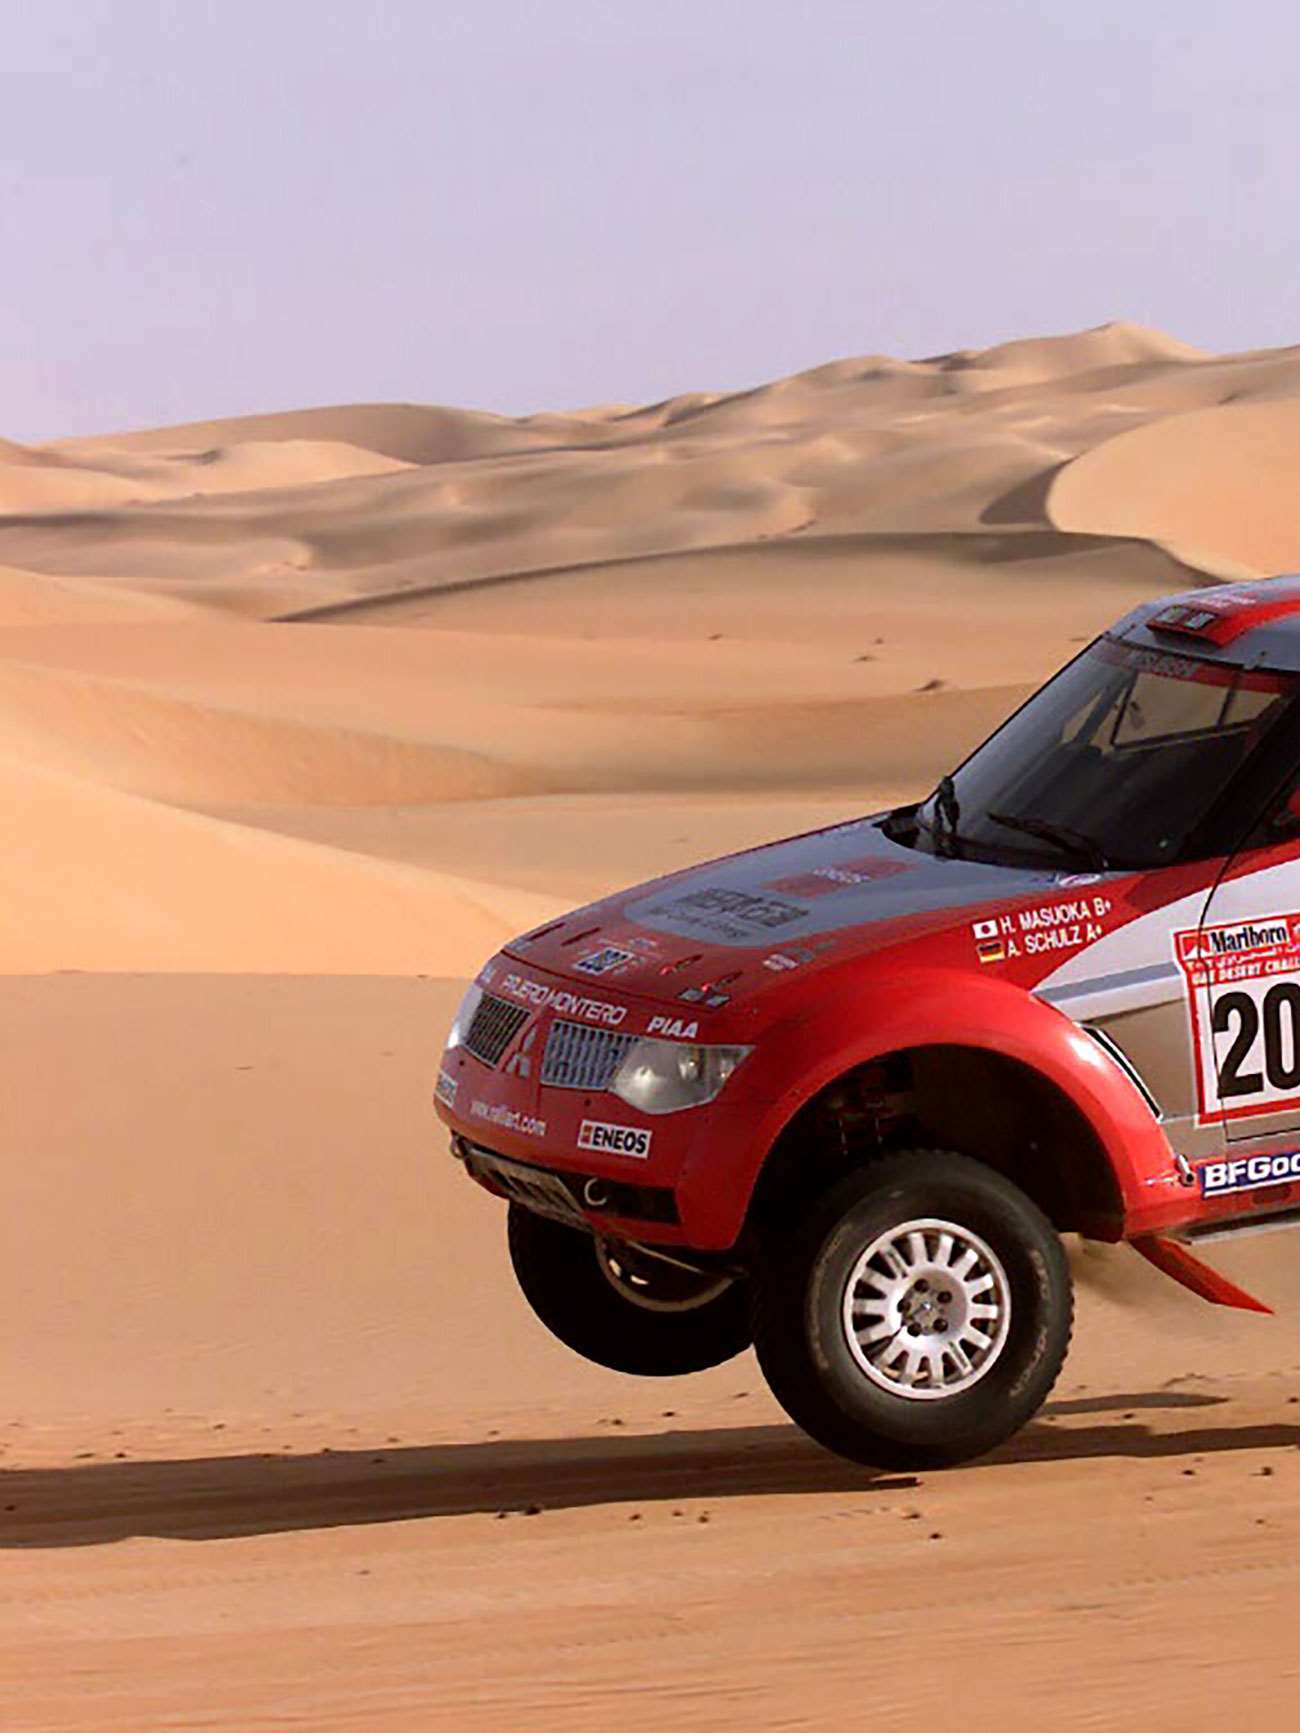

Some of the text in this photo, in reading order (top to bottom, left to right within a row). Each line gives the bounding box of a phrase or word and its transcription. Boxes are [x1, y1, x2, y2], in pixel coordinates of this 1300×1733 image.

[1019, 901, 1091, 930] MASUOKA
[1025, 925, 1082, 954] SCHULZ
[1219, 961, 1261, 981] DESERT
[647, 1015, 698, 1038] PIAA
[592, 1125, 648, 1154] ENEOS
